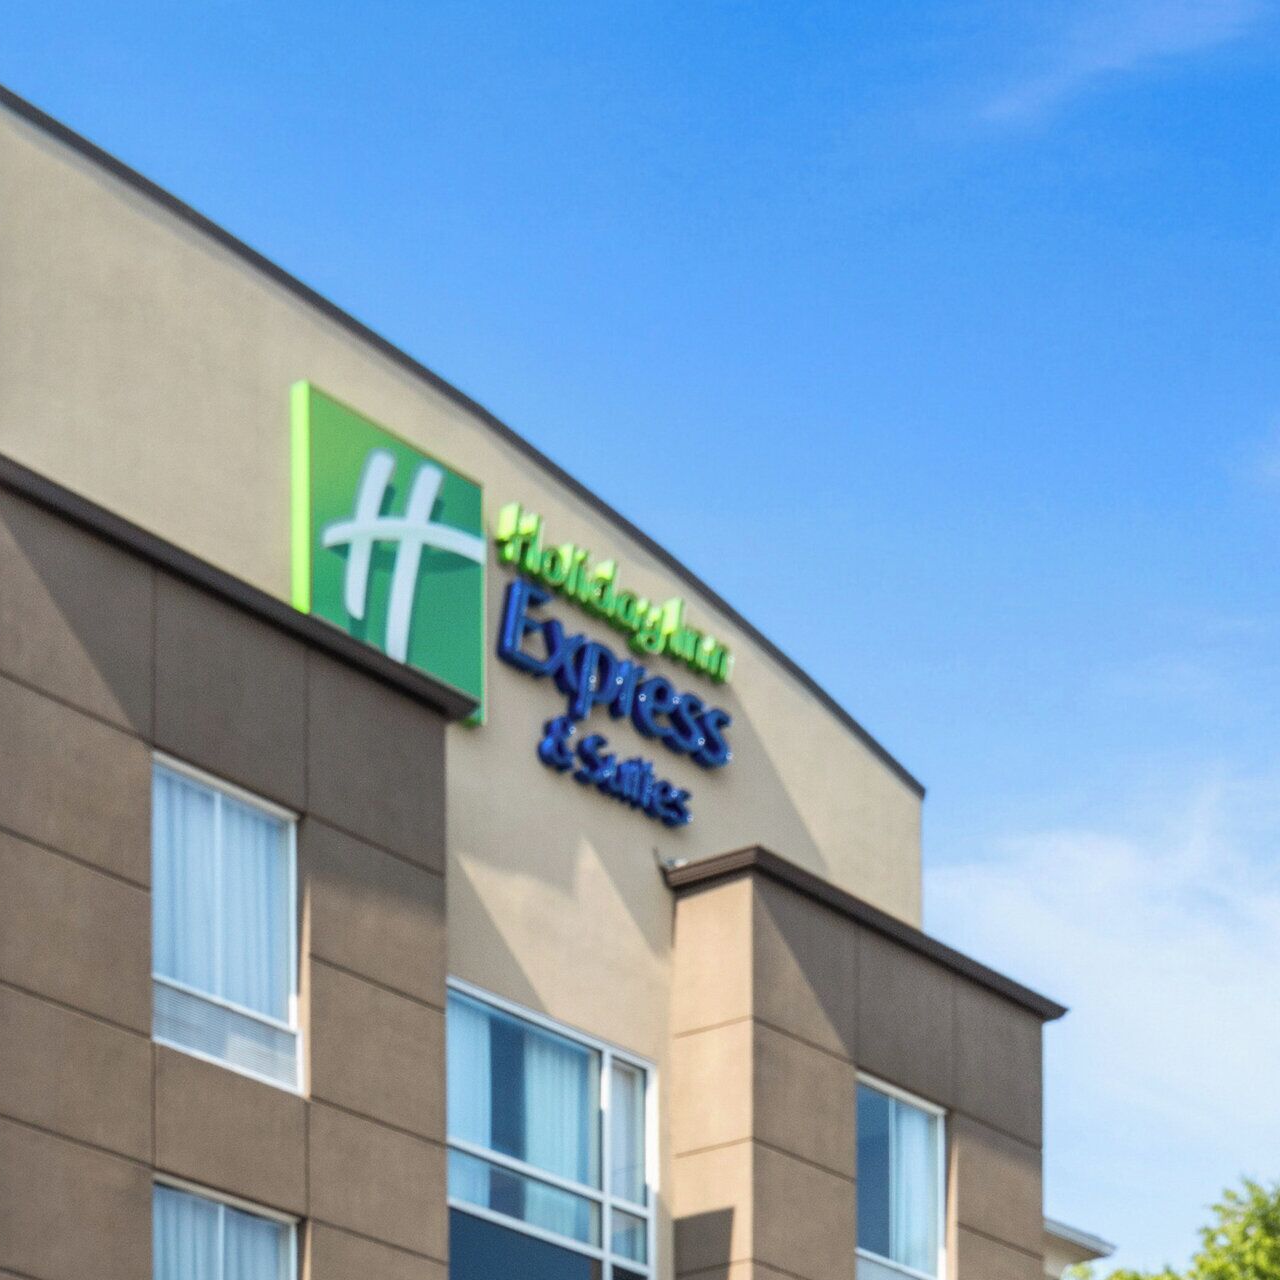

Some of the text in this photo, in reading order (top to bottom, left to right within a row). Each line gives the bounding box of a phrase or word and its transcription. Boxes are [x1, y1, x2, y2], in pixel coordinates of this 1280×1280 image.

[496, 502, 736, 685] Holiday Inn
[497, 577, 733, 770] Express
[538, 715, 694, 828] & Suites
